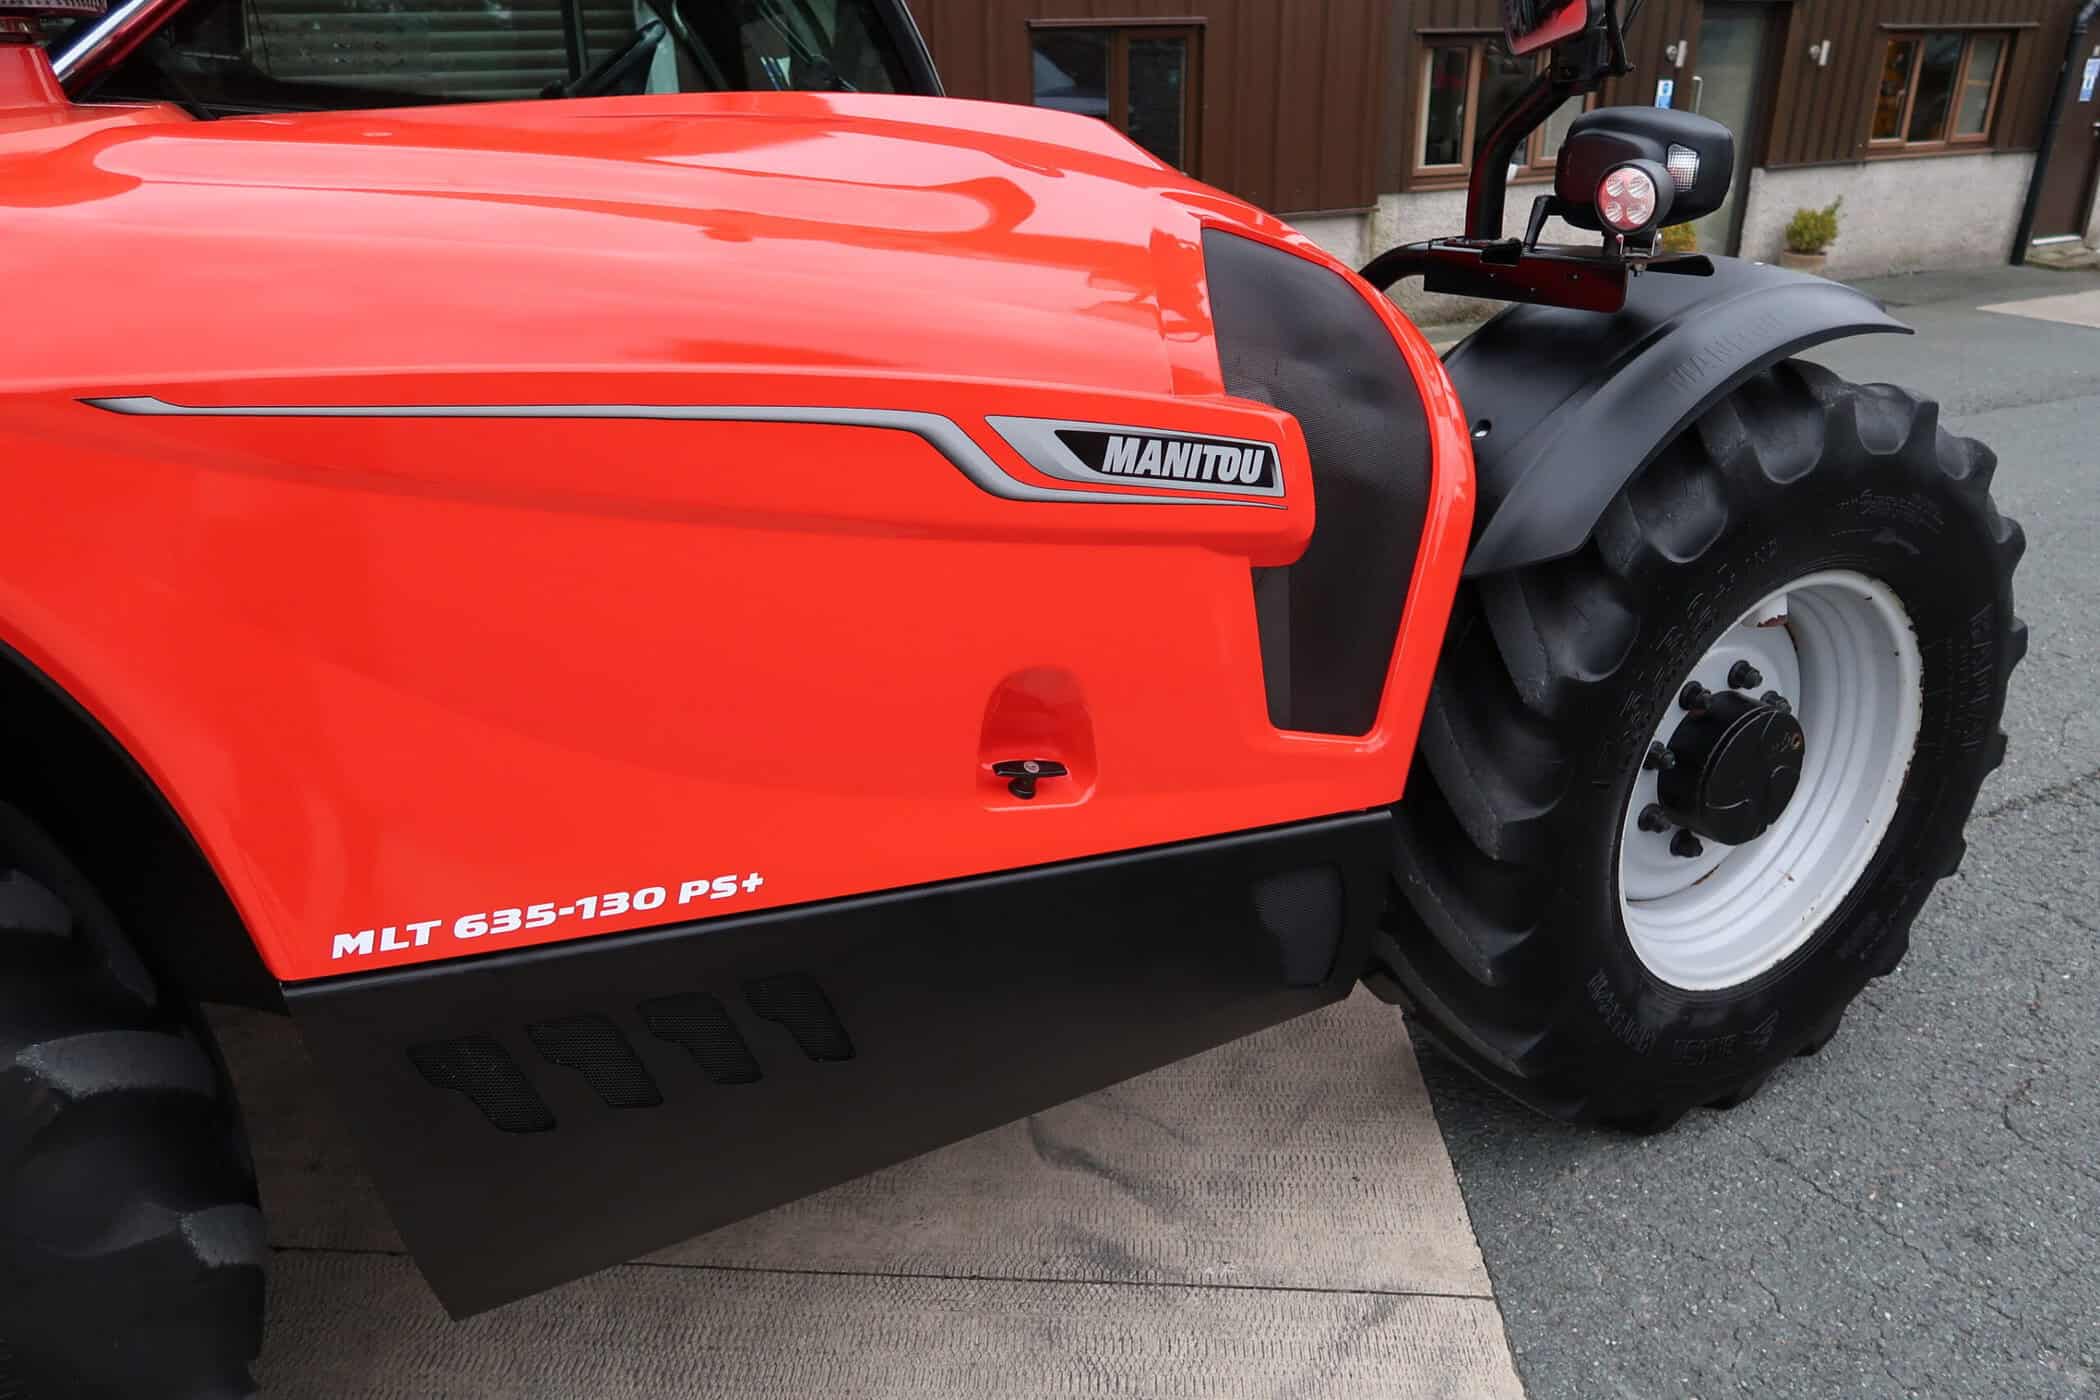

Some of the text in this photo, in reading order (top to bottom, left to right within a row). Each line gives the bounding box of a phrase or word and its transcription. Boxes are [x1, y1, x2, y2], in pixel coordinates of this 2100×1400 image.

[1101, 434, 1265, 484] MANITOU
[331, 872, 764, 959] MLT 635-130 PS+
